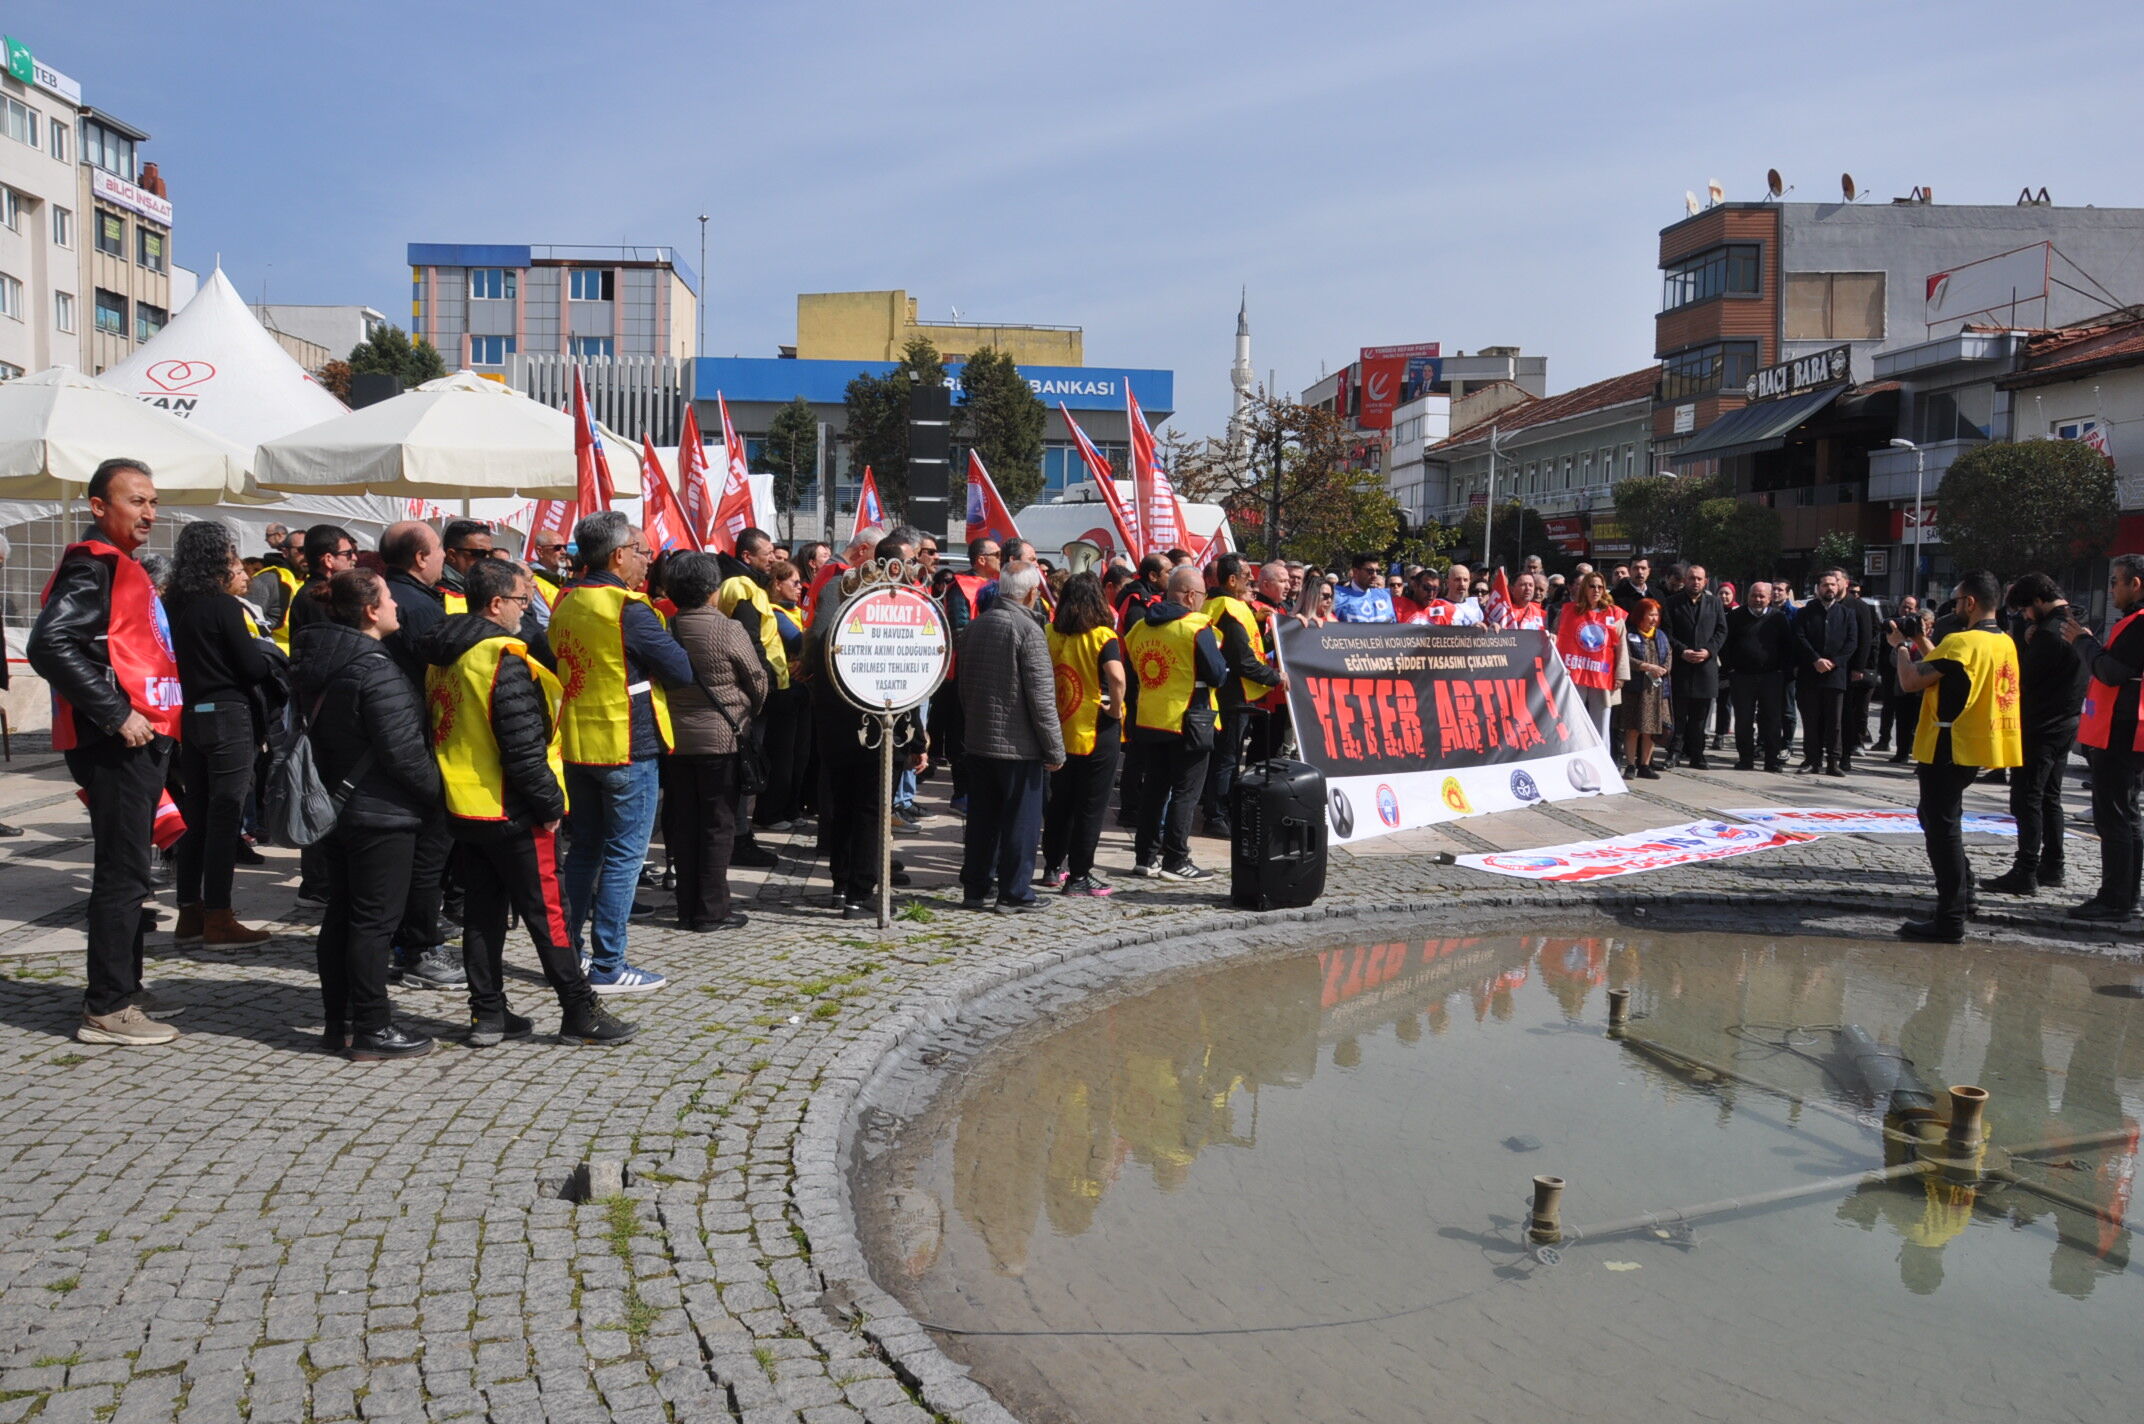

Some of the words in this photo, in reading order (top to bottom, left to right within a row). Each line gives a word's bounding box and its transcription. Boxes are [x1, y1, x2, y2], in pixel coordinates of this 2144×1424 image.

[33, 64, 57, 88] TEB
[1758, 366, 1788, 397] HACI
[1793, 354, 1829, 388] BABA
[1029, 379, 1115, 396] BANKASI
[865, 600, 913, 622] DİKKAT
[916, 606, 922, 624] !
[872, 627, 880, 639] BU
[883, 627, 914, 639] HAVUZDA
[1321, 636, 1384, 650] ÖĞRETMENLERİ
[1384, 636, 1431, 649] KORURSANIZ
[1431, 635, 1473, 648] GELECEĞİNİZİ
[1473, 636, 1517, 648] KORURSUNUZ
[840, 642, 872, 656] ELEKTRİK
[874, 645, 895, 656] AKIMI
[851, 659, 886, 673] GİRİLMESİ
[888, 659, 920, 673] TEHLİKELİ
[922, 663, 929, 673] VE
[1344, 653, 1394, 672] EĞİTİMDE
[1396, 652, 1427, 675] ŞİDDET
[1427, 656, 1466, 670] YASASINI
[1467, 654, 1508, 673] ÇIKARTIN
[1565, 653, 1610, 674] Eğitim
[875, 680, 907, 690] YASAKTIR
[1305, 676, 1427, 761] YETER
[1433, 678, 1547, 759] ARTIK
[1534, 656, 1570, 742] !
